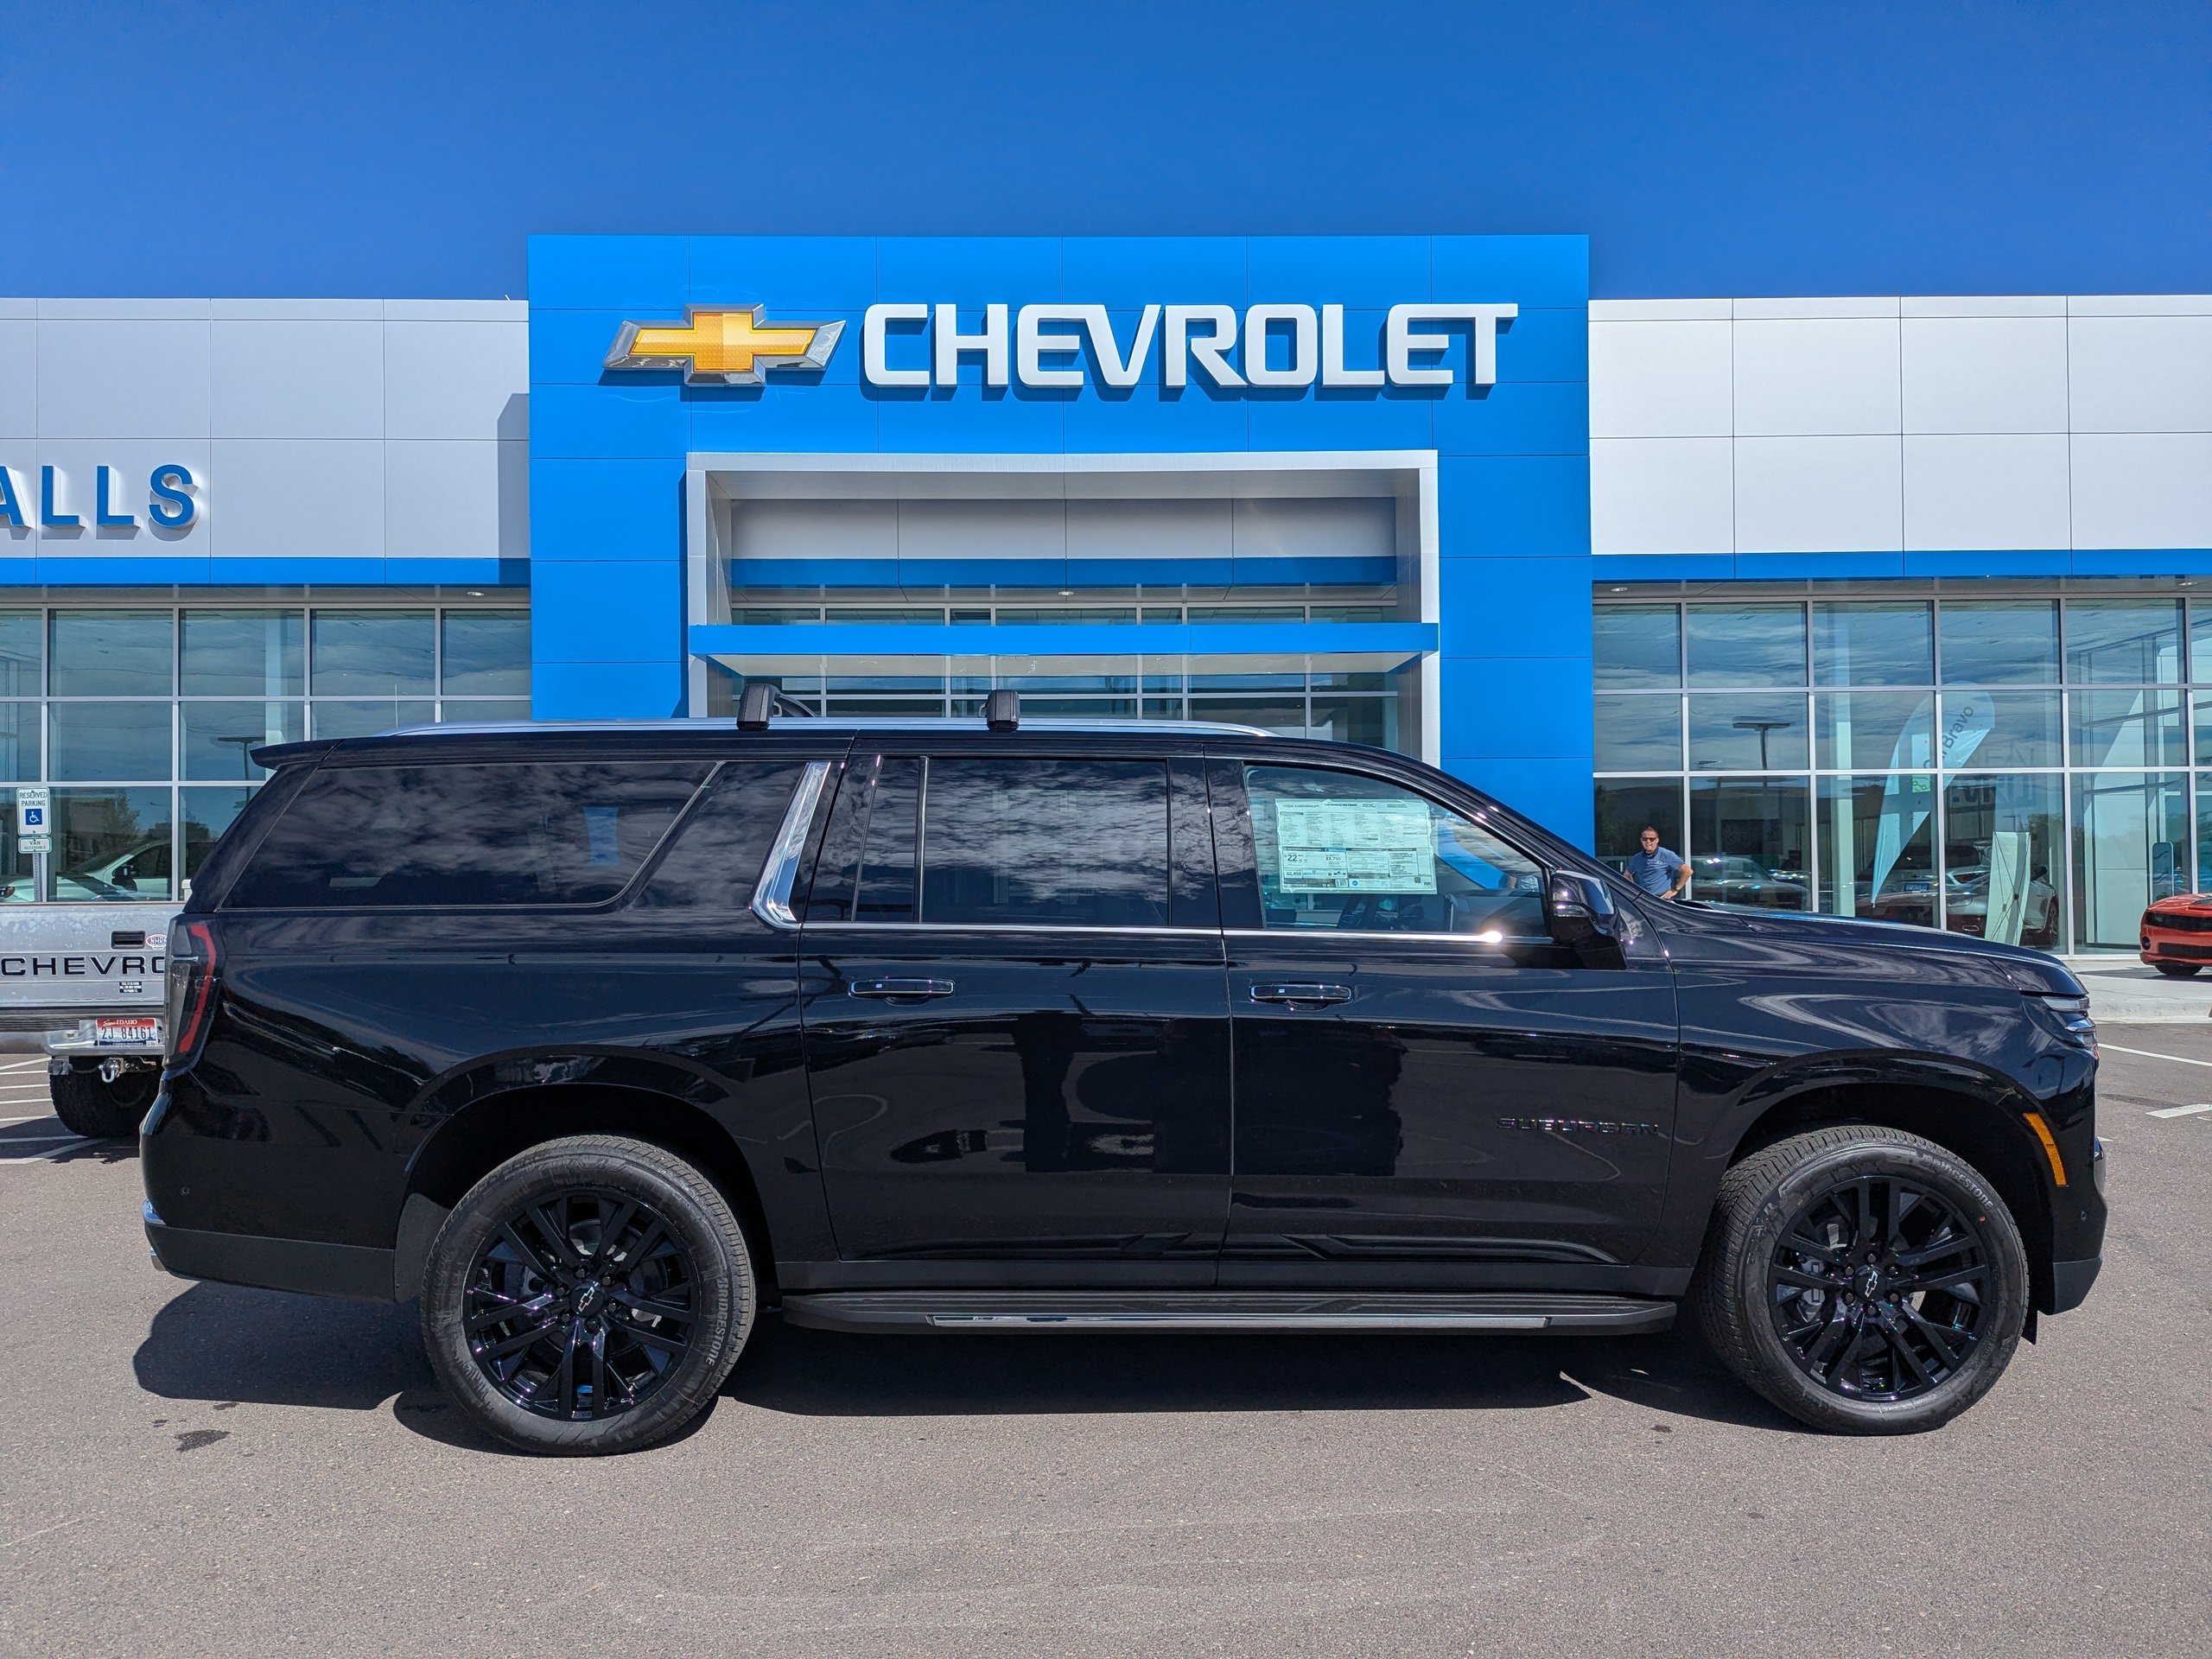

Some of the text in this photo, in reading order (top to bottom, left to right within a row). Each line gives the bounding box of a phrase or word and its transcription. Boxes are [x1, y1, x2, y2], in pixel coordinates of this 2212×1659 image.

[864, 303, 1518, 389] CHEVROLET
[102, 1027, 152, 1039] 2J 84161
[1923, 1154, 1993, 1210] BRIDGESTONE
[706, 1278, 728, 1366] BRIDGESTONE
